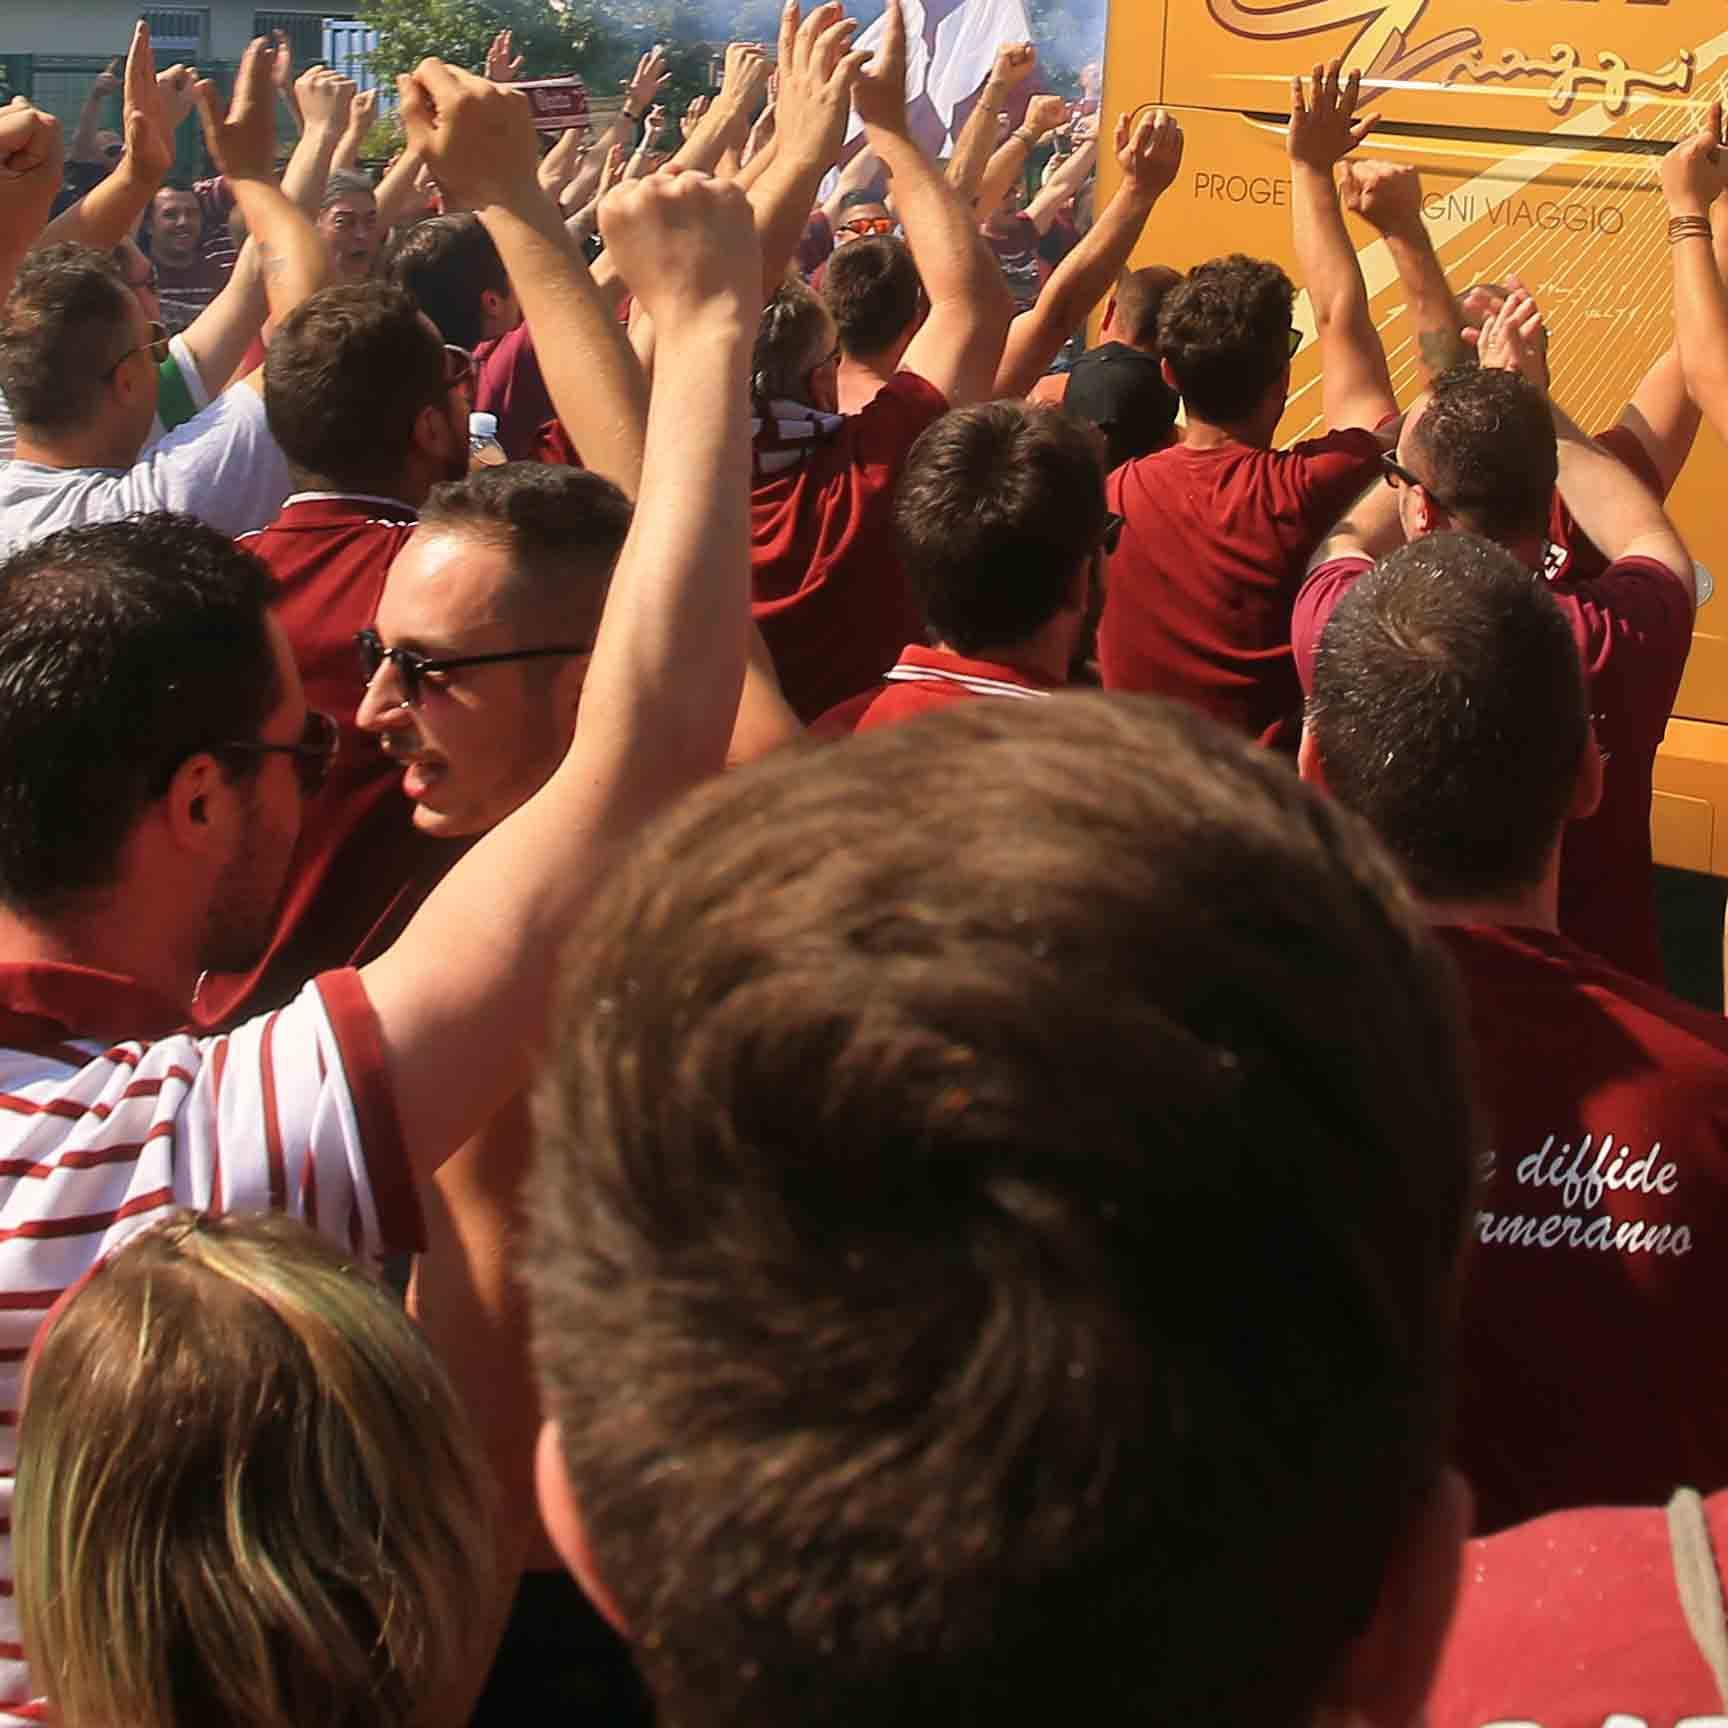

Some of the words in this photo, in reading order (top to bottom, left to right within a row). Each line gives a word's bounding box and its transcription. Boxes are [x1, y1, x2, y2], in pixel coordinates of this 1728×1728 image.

[1350, 26, 1697, 117] Viaggi
[1194, 172, 1292, 205] PROGE
[1421, 193, 1475, 223] GNI
[1484, 196, 1625, 235] VIAGGIO
[1515, 1133, 1680, 1210] diffide
[1475, 1209, 1693, 1257] rmeranno
